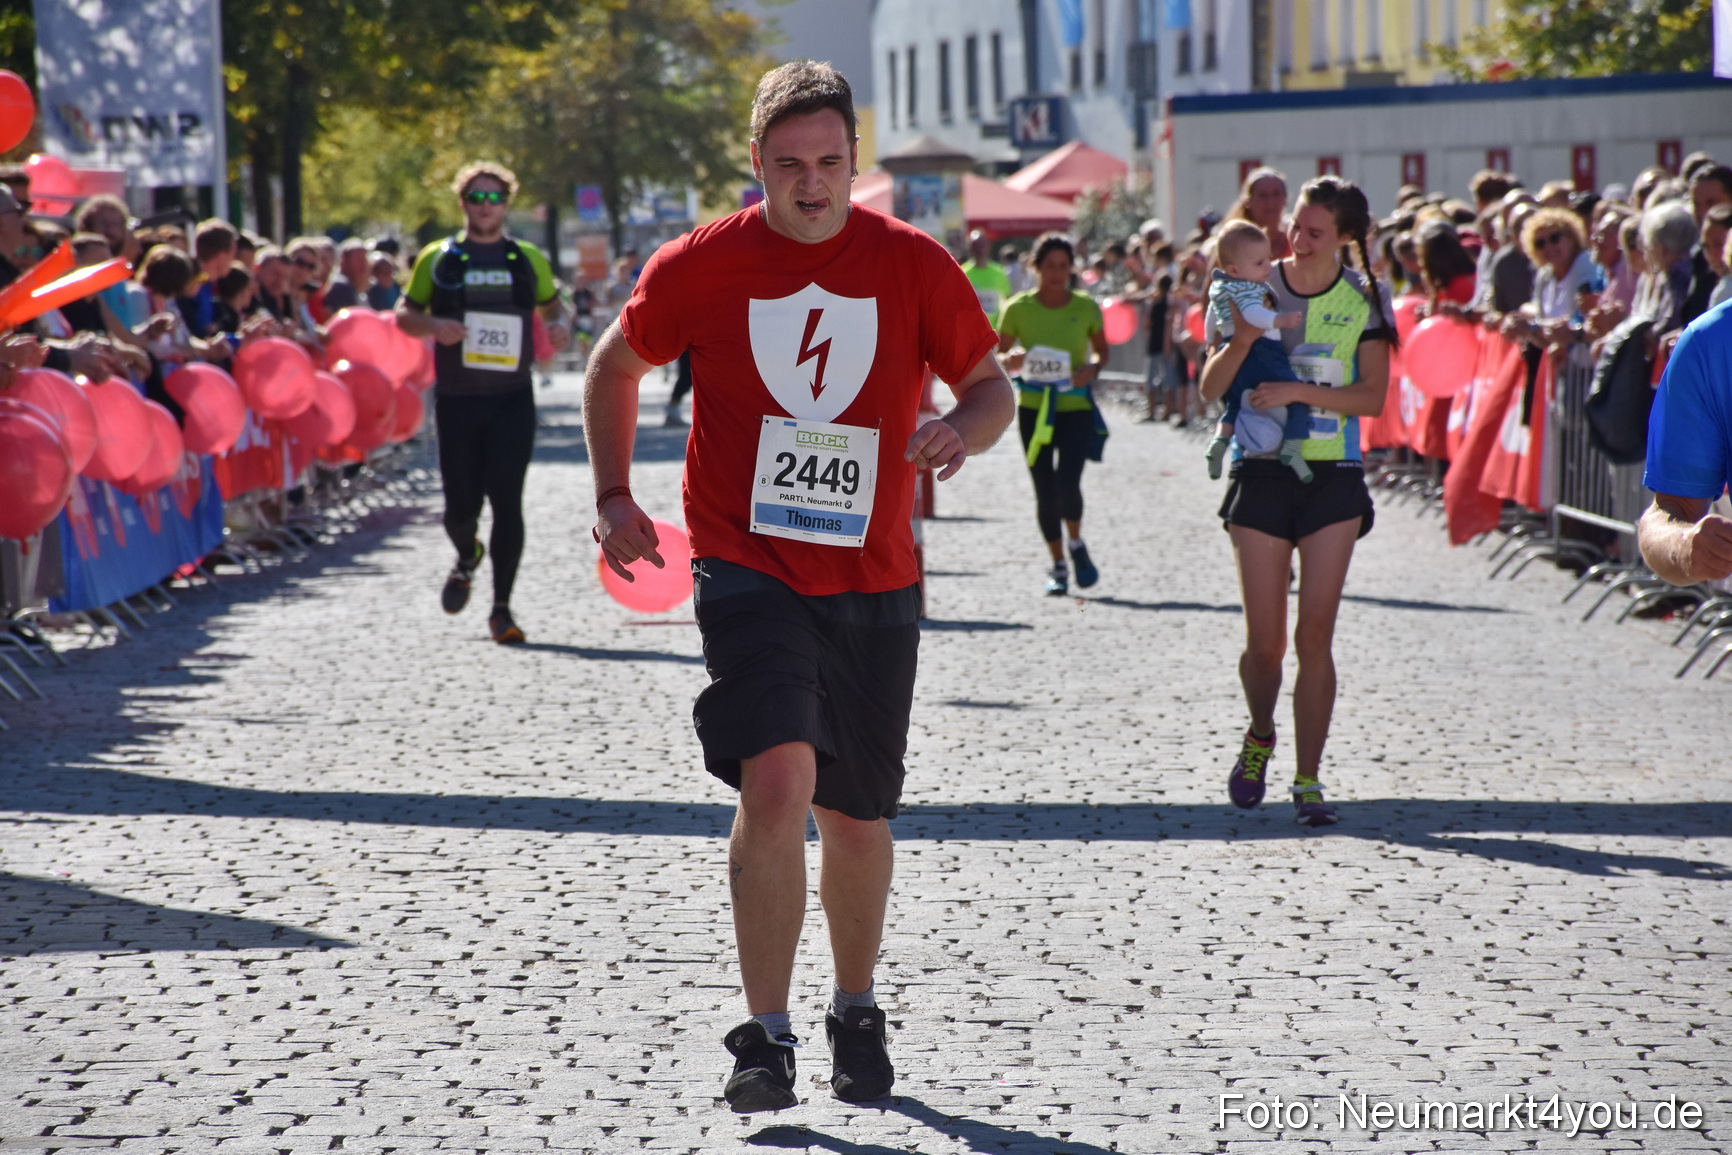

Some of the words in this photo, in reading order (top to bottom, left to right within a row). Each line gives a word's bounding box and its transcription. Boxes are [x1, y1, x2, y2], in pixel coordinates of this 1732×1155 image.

[478, 329, 509, 348] 283
[796, 430, 849, 449] BOCK
[773, 451, 860, 496] 2449
[779, 493, 806, 504] PARTL
[807, 494, 843, 508] Neumarkt
[786, 509, 842, 531] Thomas
